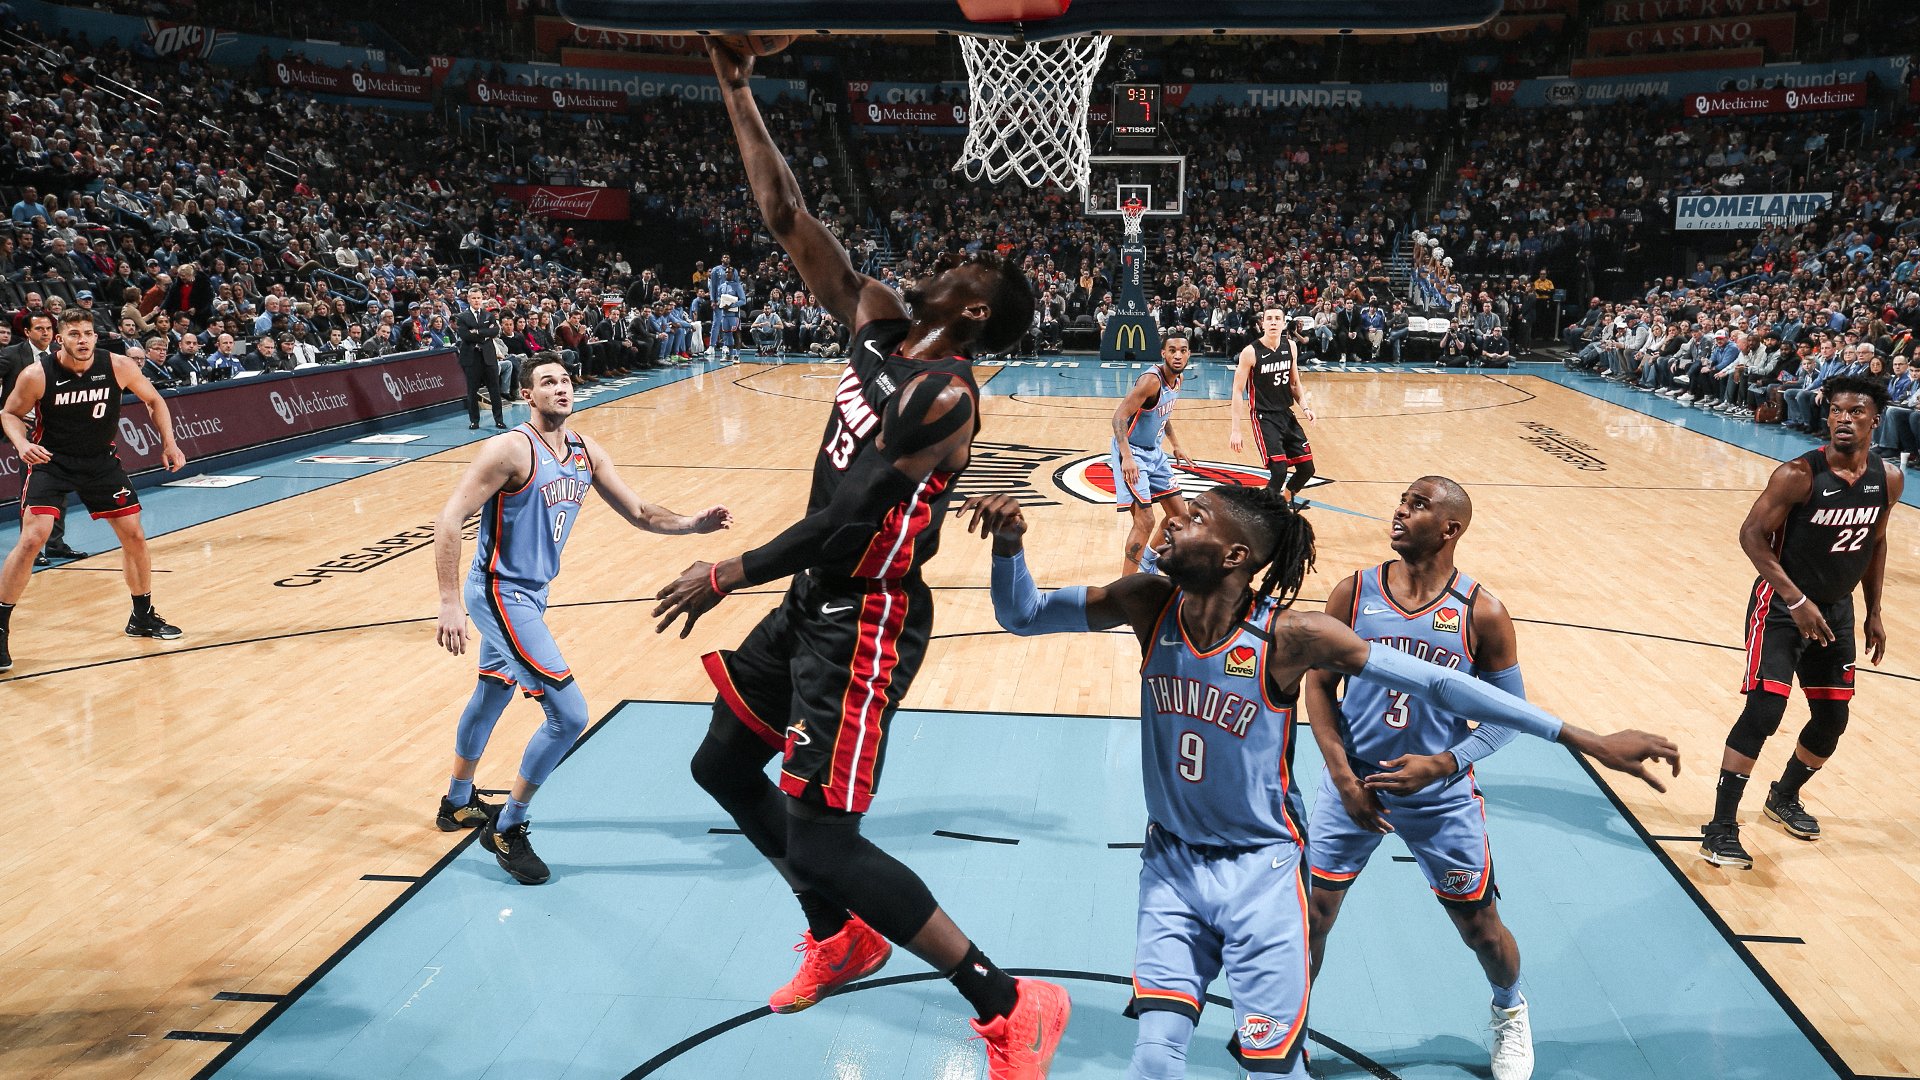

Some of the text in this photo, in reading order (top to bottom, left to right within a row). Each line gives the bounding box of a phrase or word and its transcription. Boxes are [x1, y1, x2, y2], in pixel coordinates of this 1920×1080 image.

[154, 25, 202, 56] OKC
[1626, 22, 1752, 48] CASINO
[365, 49, 385, 62] 118
[431, 57, 449, 68] 119
[290, 70, 339, 87] Medicine
[368, 77, 421, 94] Medicine
[788, 80, 806, 90] 119
[1493, 81, 1515, 91] 102
[849, 82, 868, 92] 120
[1127, 88, 1154, 101] 9:31
[1165, 85, 1183, 94] 101
[1429, 82, 1448, 92] 101
[1553, 81, 1669, 100] FOX OKLAHOMA
[491, 89, 539, 104] Medicine
[567, 94, 618, 108] Medicine
[1247, 89, 1363, 107] THUNDER
[1711, 97, 1769, 111] Medicine
[1800, 90, 1855, 105] Medicine
[883, 108, 937, 121] Medicine
[1139, 101, 1151, 122] 7
[532, 196, 592, 208] Budweiser
[1679, 194, 1826, 218] HOMELAND
[1699, 219, 1730, 229] fresh
[1132, 257, 1140, 286] devon
[1117, 308, 1146, 316] Medicine
[1260, 360, 1291, 374] MIAMI
[397, 371, 444, 396] Medicine
[1273, 371, 1290, 386] 55
[54, 387, 110, 406] MIAMI
[289, 389, 349, 417] Medicine
[92, 402, 107, 419] 0
[824, 418, 855, 470] 13
[540, 477, 590, 508] THUNDER
[1809, 506, 1881, 526] MIAMI
[553, 510, 567, 543] 8
[1829, 526, 1870, 552] 22
[273, 519, 442, 588] CHESAPEA
[1434, 620, 1458, 631] Love's
[1226, 663, 1254, 676] Love's
[1147, 675, 1260, 739] THUNDER
[1384, 688, 1410, 730] 3
[1177, 730, 1207, 784] 9
[1446, 874, 1467, 887] OKC
[1242, 1022, 1270, 1038] OKC
